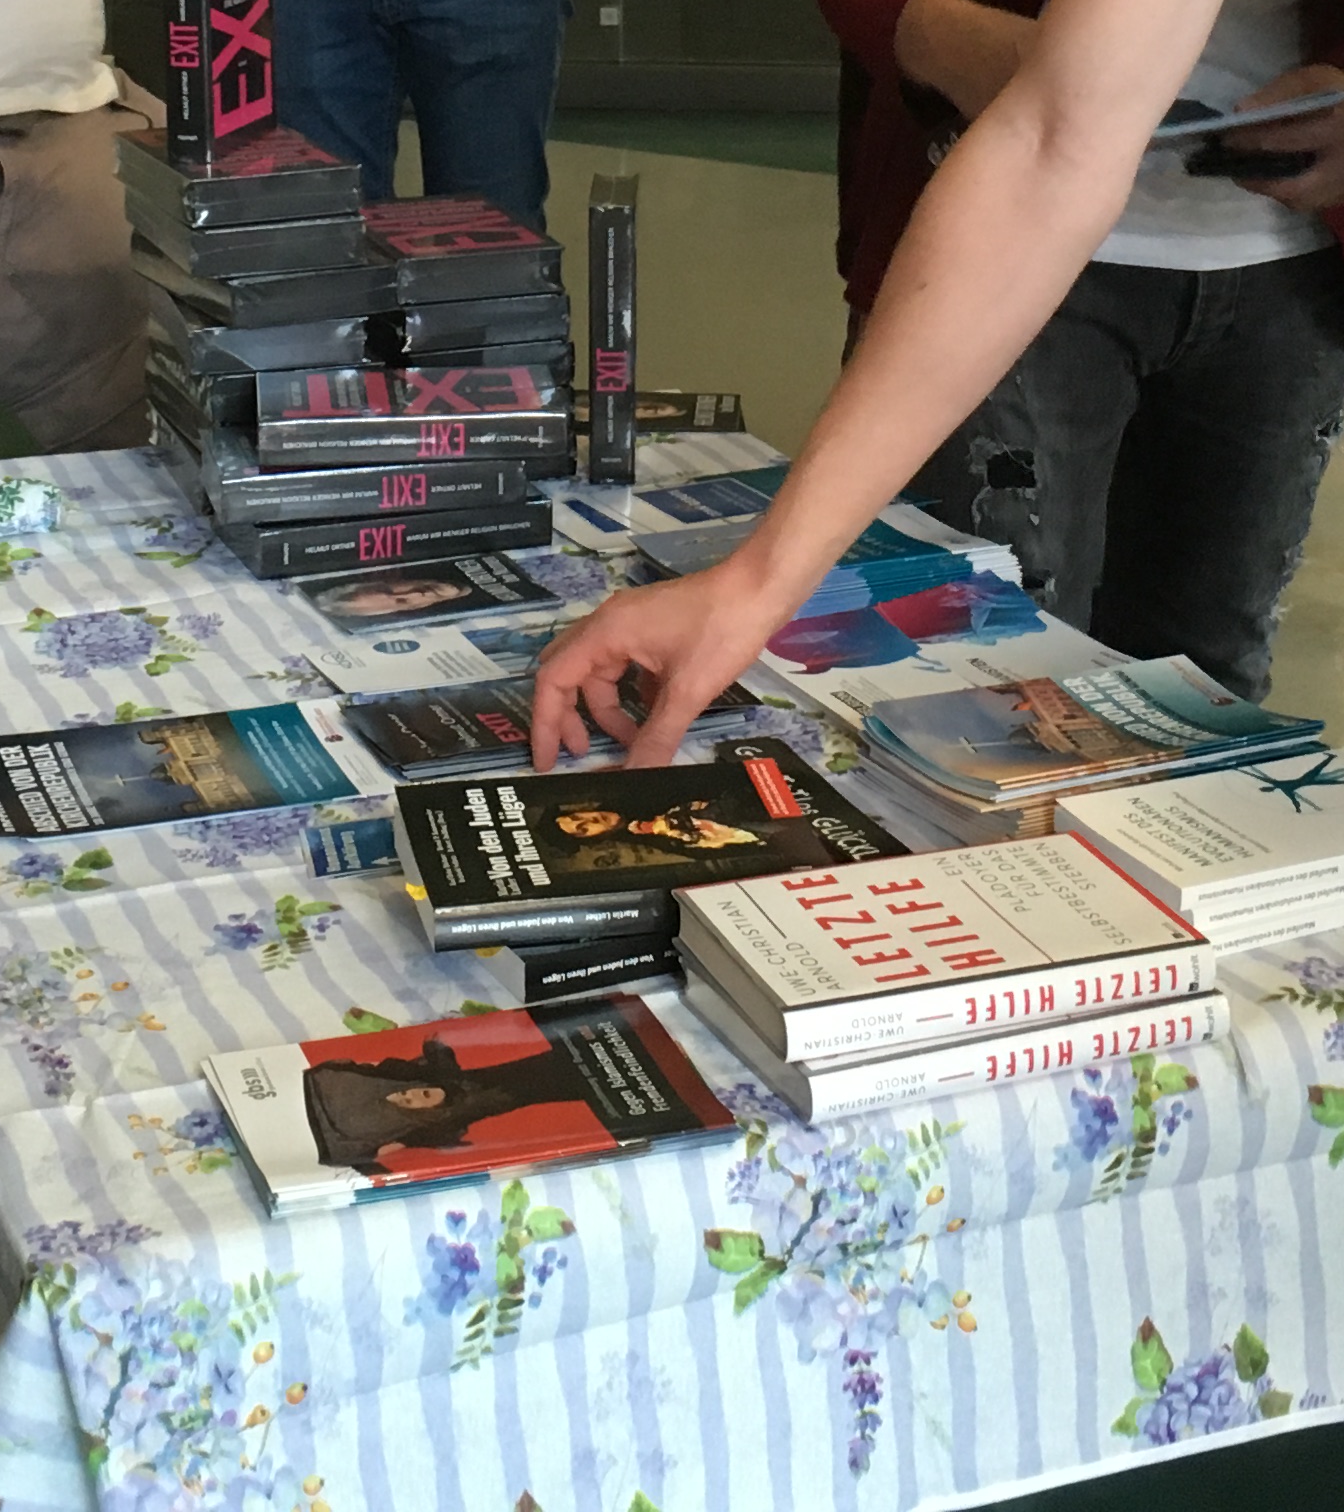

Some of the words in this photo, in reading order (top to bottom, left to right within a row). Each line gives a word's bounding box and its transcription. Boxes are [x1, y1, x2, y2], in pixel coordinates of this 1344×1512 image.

[169, 21, 200, 70] EXIT
[596, 348, 628, 392] EXIT
[282, 366, 543, 418] EXIT
[416, 423, 466, 457] EXIT
[378, 474, 427, 509] EXIT
[358, 524, 406, 561] EXIT
[1062, 676, 1105, 702] DER
[475, 712, 530, 743] EXIT
[1089, 701, 1135, 725] VON
[7, 768, 38, 792] VON
[26, 743, 90, 829] KIRCHENREPUBLIK
[18, 791, 62, 833] ABSCHIED
[463, 788, 495, 827] Juden
[496, 786, 527, 828] Lügen
[1123, 812, 1154, 830] DES
[477, 830, 504, 854] den
[511, 829, 541, 863] ihren
[1164, 805, 1255, 859] HUMANISMUS
[981, 848, 1017, 872] DAS
[1146, 826, 1214, 868] MANIFEST
[487, 856, 514, 881] Von
[518, 864, 552, 886] und
[932, 856, 964, 877] EIN
[1034, 841, 1098, 892] STERBEN
[957, 853, 1033, 914] PLÄDOYER
[1005, 846, 1132, 946] SELBSTBESTIMMTE
[1009, 874, 1045, 898] FÜR
[451, 923, 477, 934] Lügen
[477, 921, 500, 932] ihren
[501, 921, 516, 931] und
[517, 917, 541, 928] Juden
[541, 916, 557, 926] den
[558, 915, 574, 925] Von
[585, 911, 612, 921] Luther
[613, 909, 639, 919] Martin
[780, 873, 932, 984] LETZTE
[866, 877, 1006, 971] HILFE
[624, 957, 639, 967] den
[639, 953, 655, 963] Von
[717, 900, 816, 998] UWE-CHRISTIAN
[566, 967, 587, 979] ihren
[587, 964, 602, 976] und
[602, 958, 624, 971] Juden
[785, 941, 845, 992] ARNOLD
[1074, 964, 1178, 1007] LETZTE
[965, 984, 1055, 1025] HILFE
[851, 1011, 904, 1029] ARNOLD
[804, 1025, 905, 1051] UWE-CHRISTIAN
[1092, 1015, 1193, 1060] LETZTE
[588, 1041, 628, 1088] Islamismus
[597, 1020, 671, 1113] Fremdenfeindlichkeit
[986, 1040, 1073, 1082] HILFE
[875, 1071, 926, 1091] ARNOLD
[620, 1089, 647, 1116] Gegen
